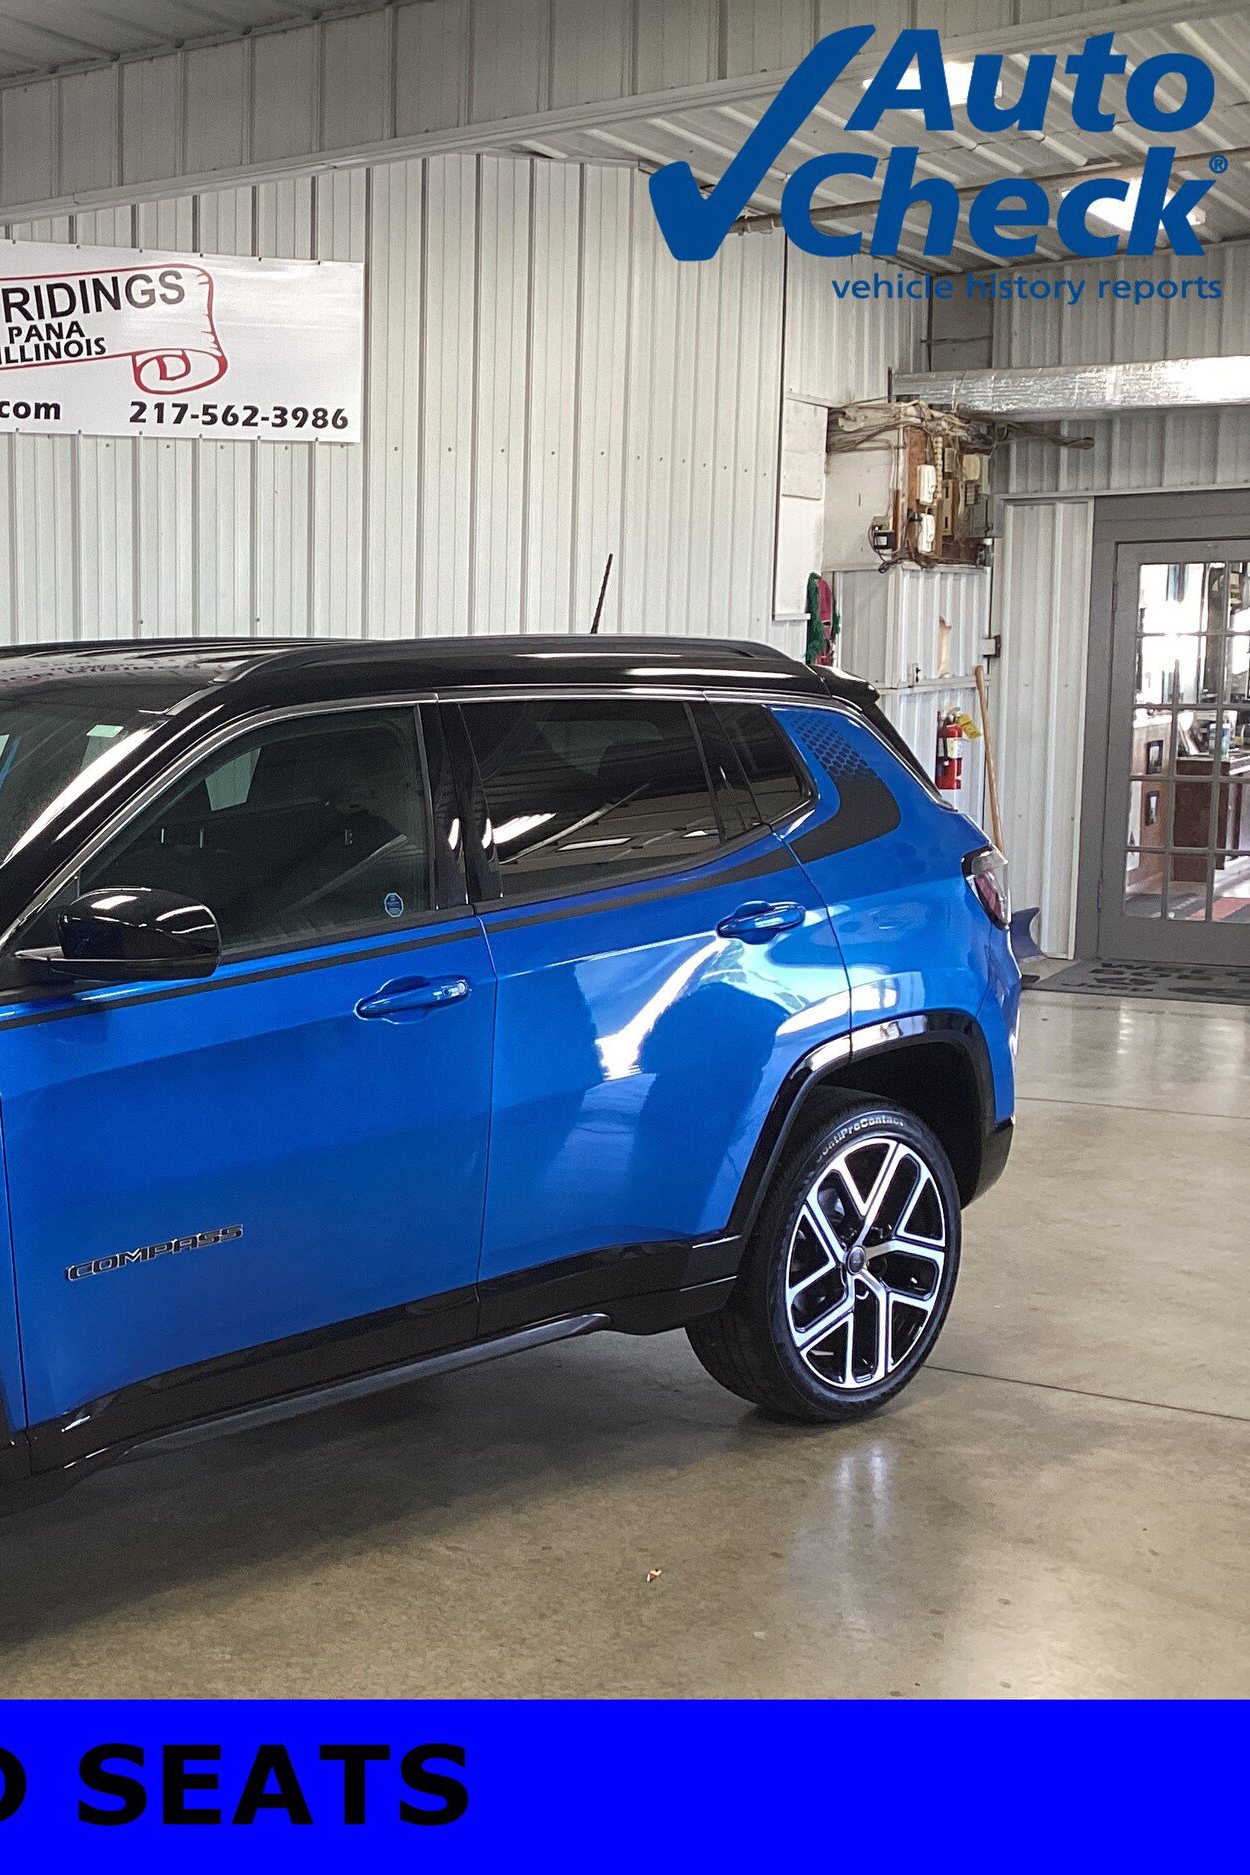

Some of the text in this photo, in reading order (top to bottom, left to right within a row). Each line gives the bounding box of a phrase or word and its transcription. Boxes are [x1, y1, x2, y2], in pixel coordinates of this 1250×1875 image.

[2, 270, 186, 323] RIDINGS
[7, 324, 86, 345] PANA
[129, 400, 348, 430] 217-562-3986
[66, 1223, 244, 1281] COMPASS
